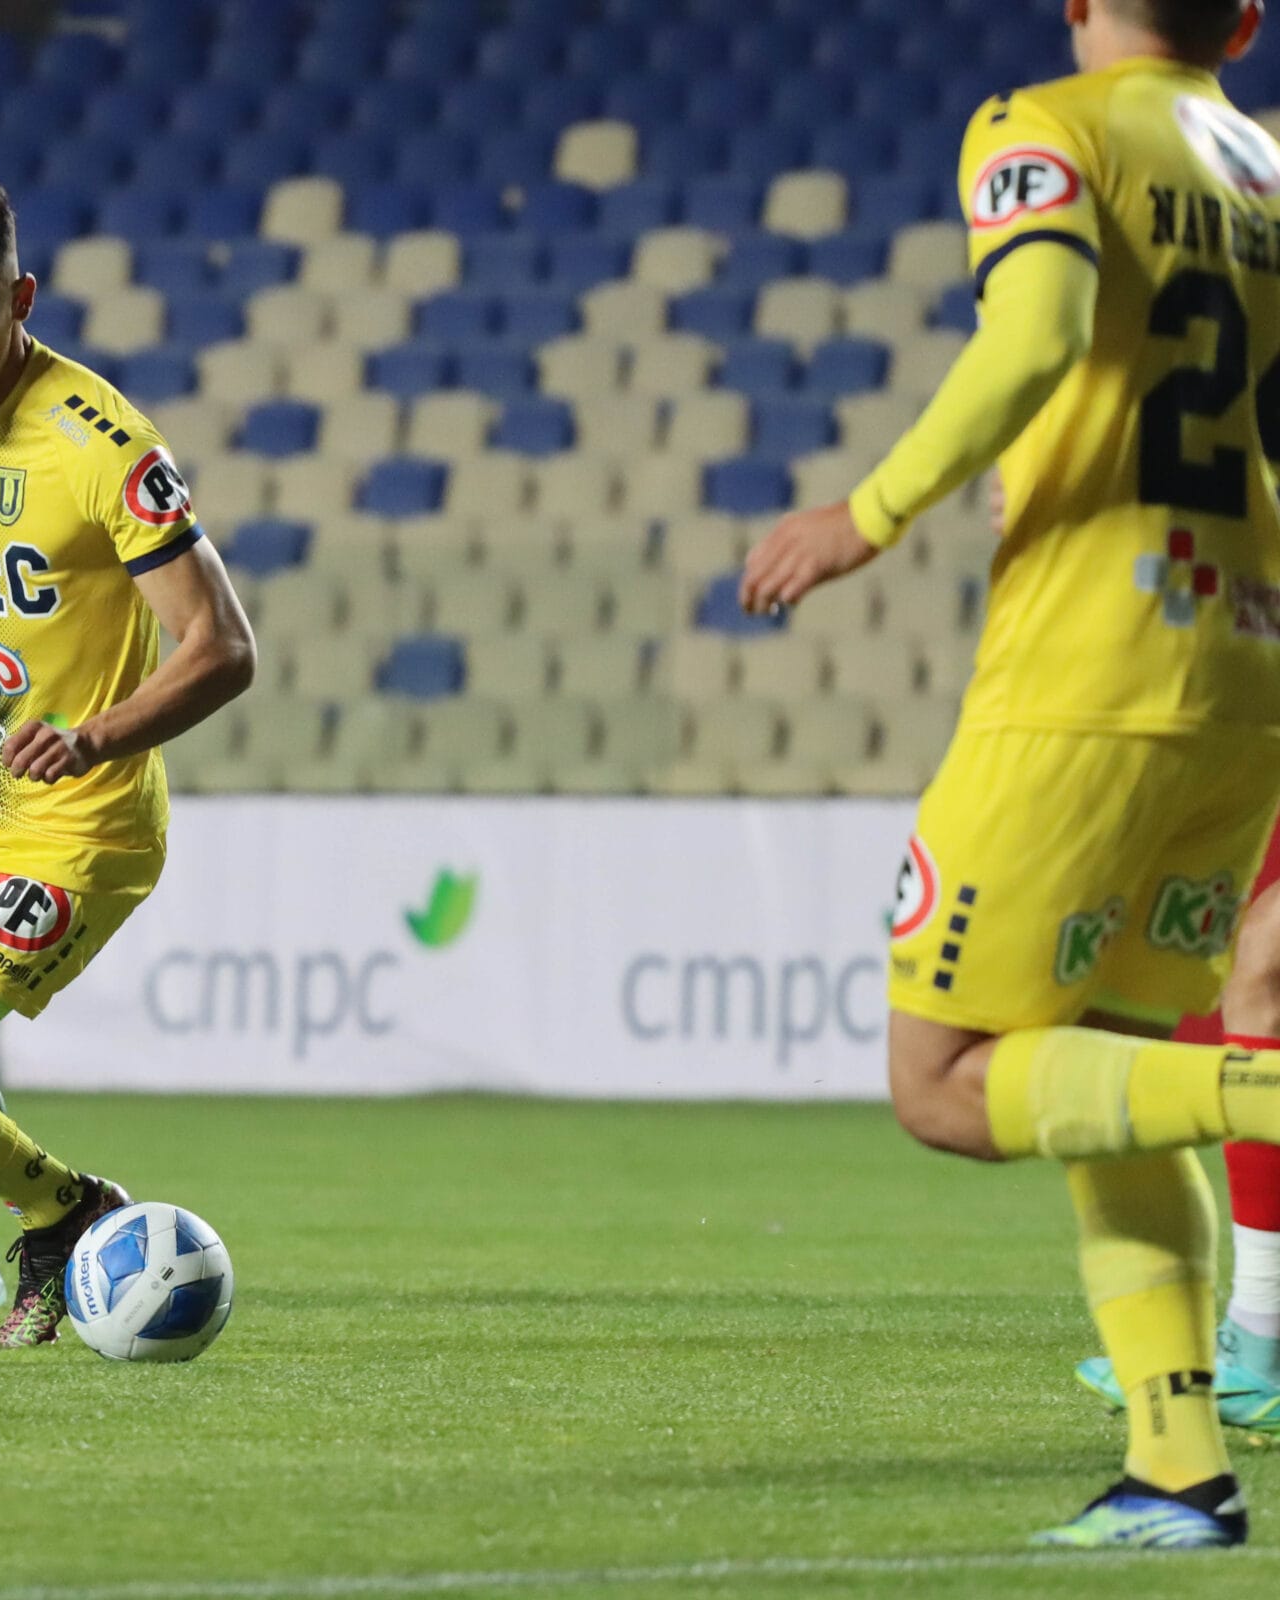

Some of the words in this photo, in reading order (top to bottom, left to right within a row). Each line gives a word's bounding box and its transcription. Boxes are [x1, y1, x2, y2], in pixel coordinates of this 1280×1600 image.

[990, 164, 1047, 213] PF
[144, 948, 400, 1062] cmpc
[622, 952, 884, 1066] cmpc
[80, 1250, 99, 1316] molten
